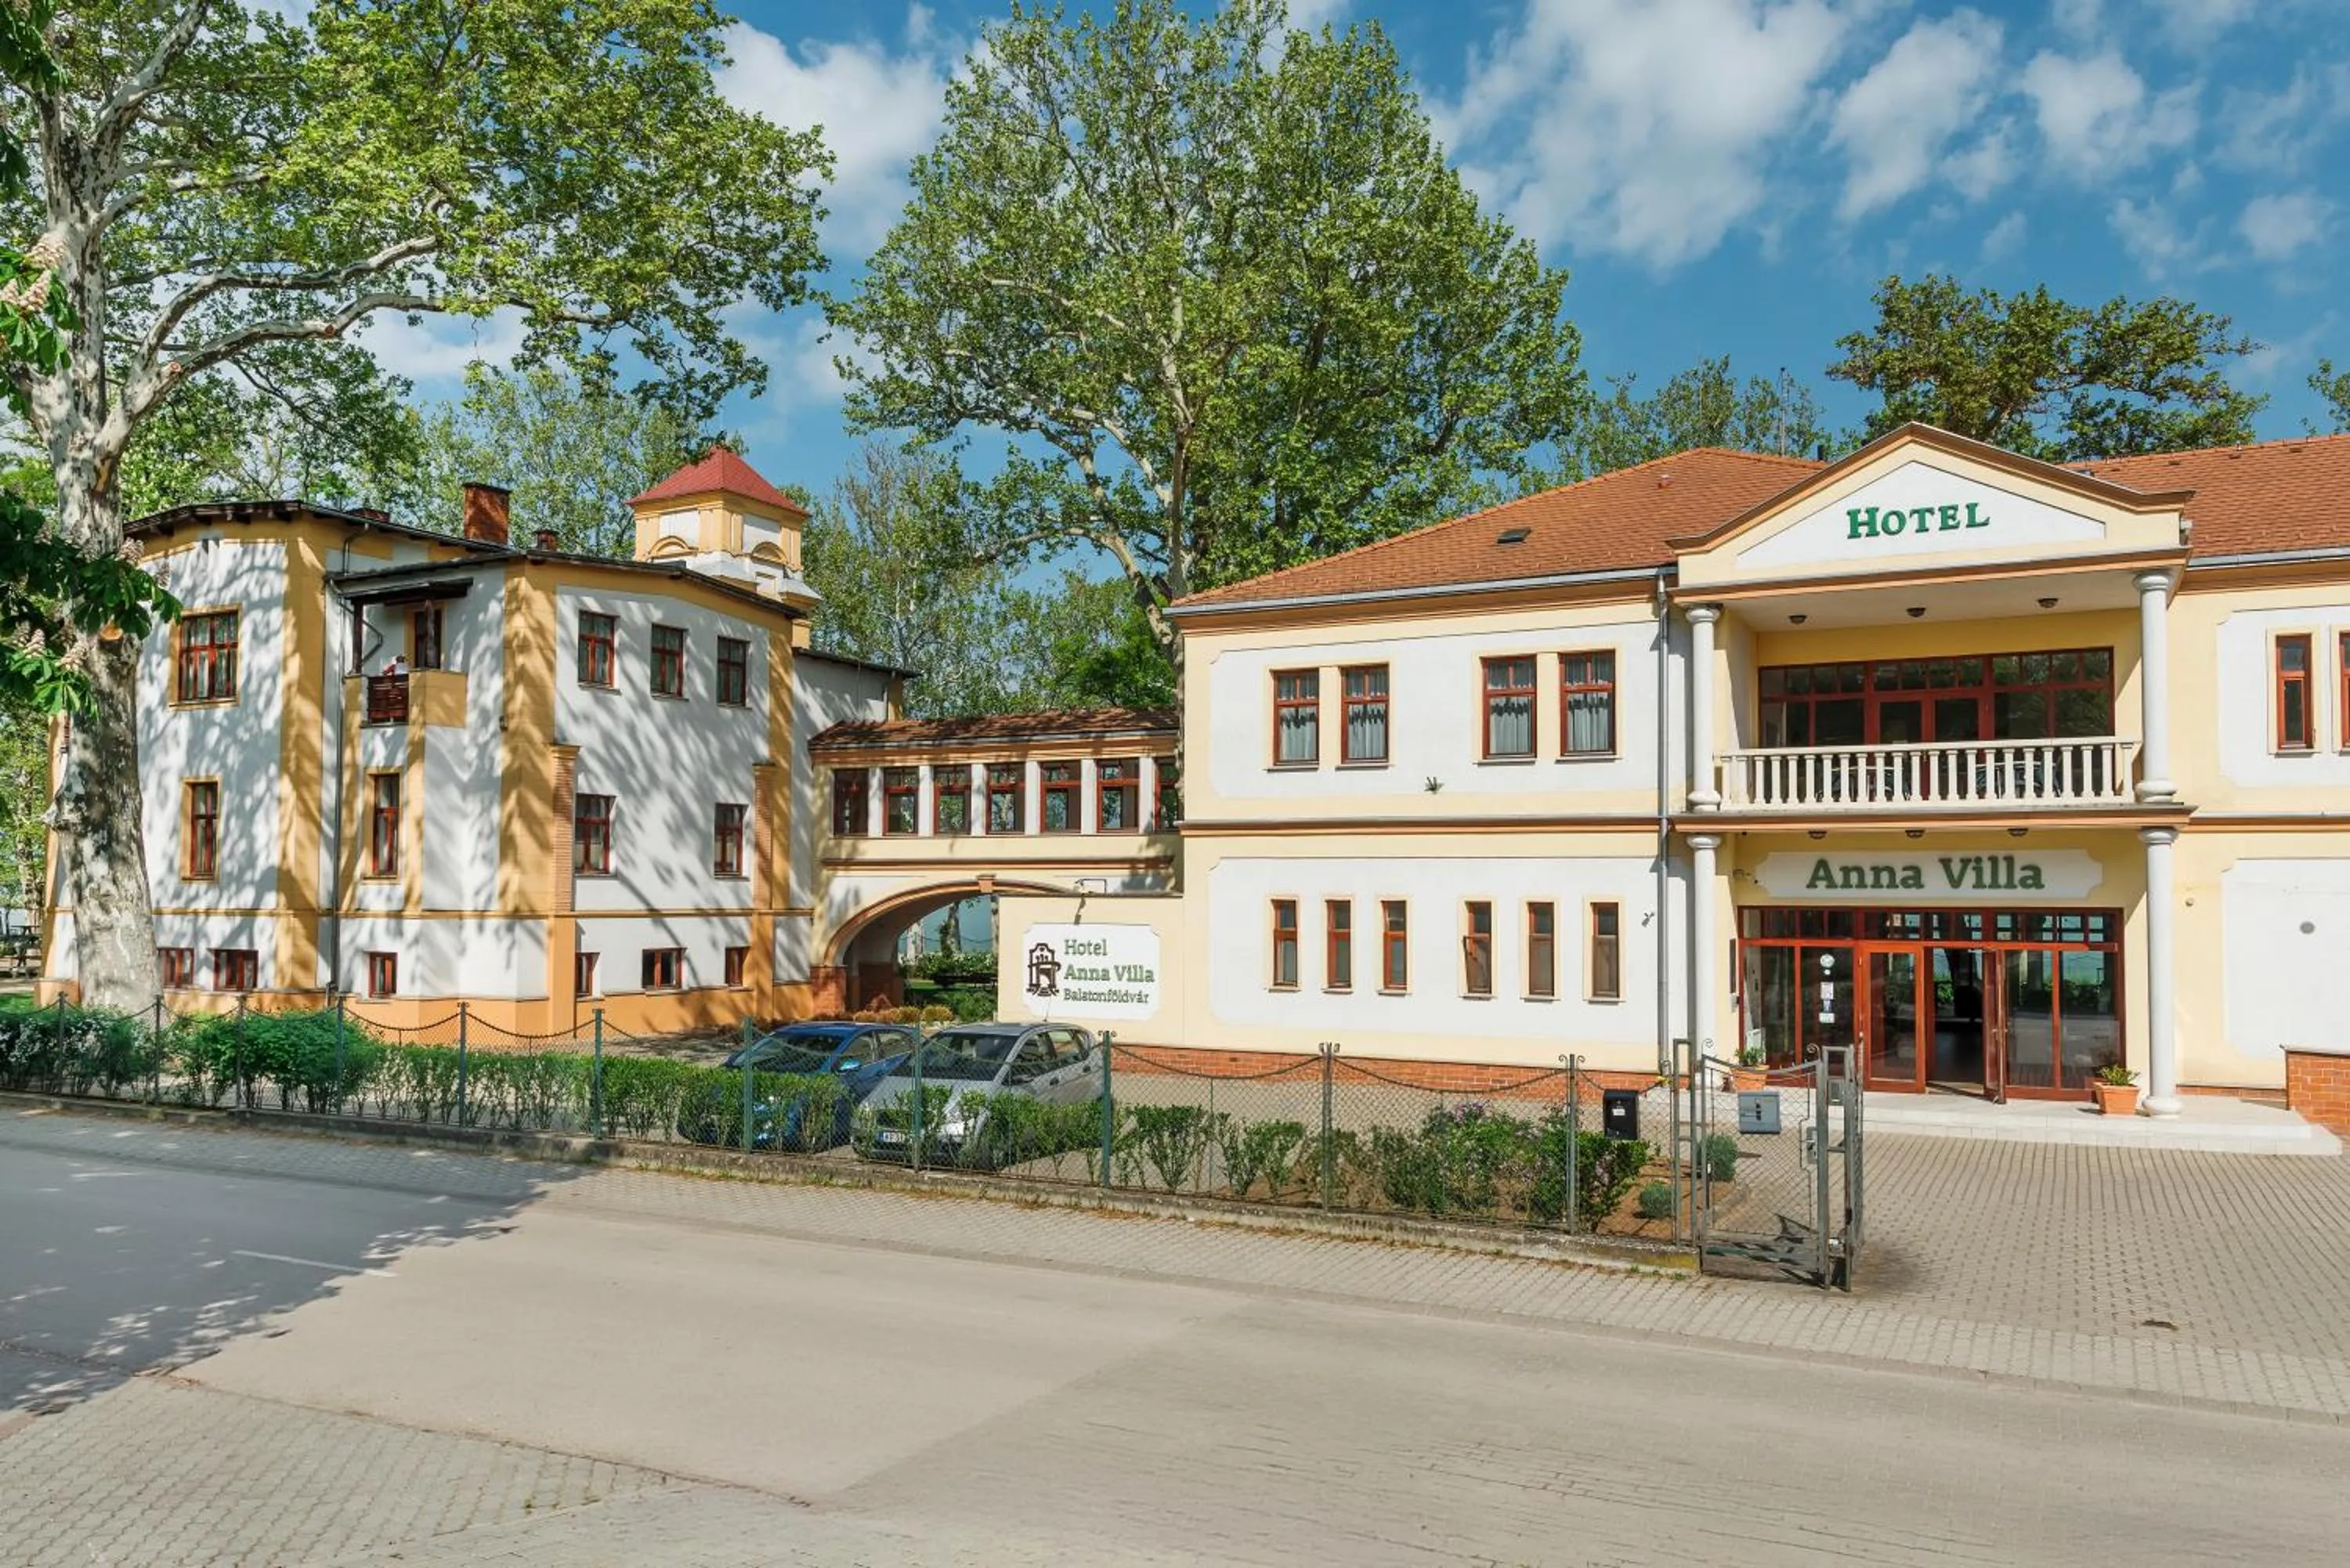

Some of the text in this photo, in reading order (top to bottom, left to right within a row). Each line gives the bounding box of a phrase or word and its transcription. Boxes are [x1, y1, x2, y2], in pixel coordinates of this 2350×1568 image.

[1846, 502, 1990, 539] HOTEL
[1806, 854, 2045, 890] Anna Villa
[1064, 939, 1108, 956] Hotel
[1064, 963, 1155, 983] Anna Villa
